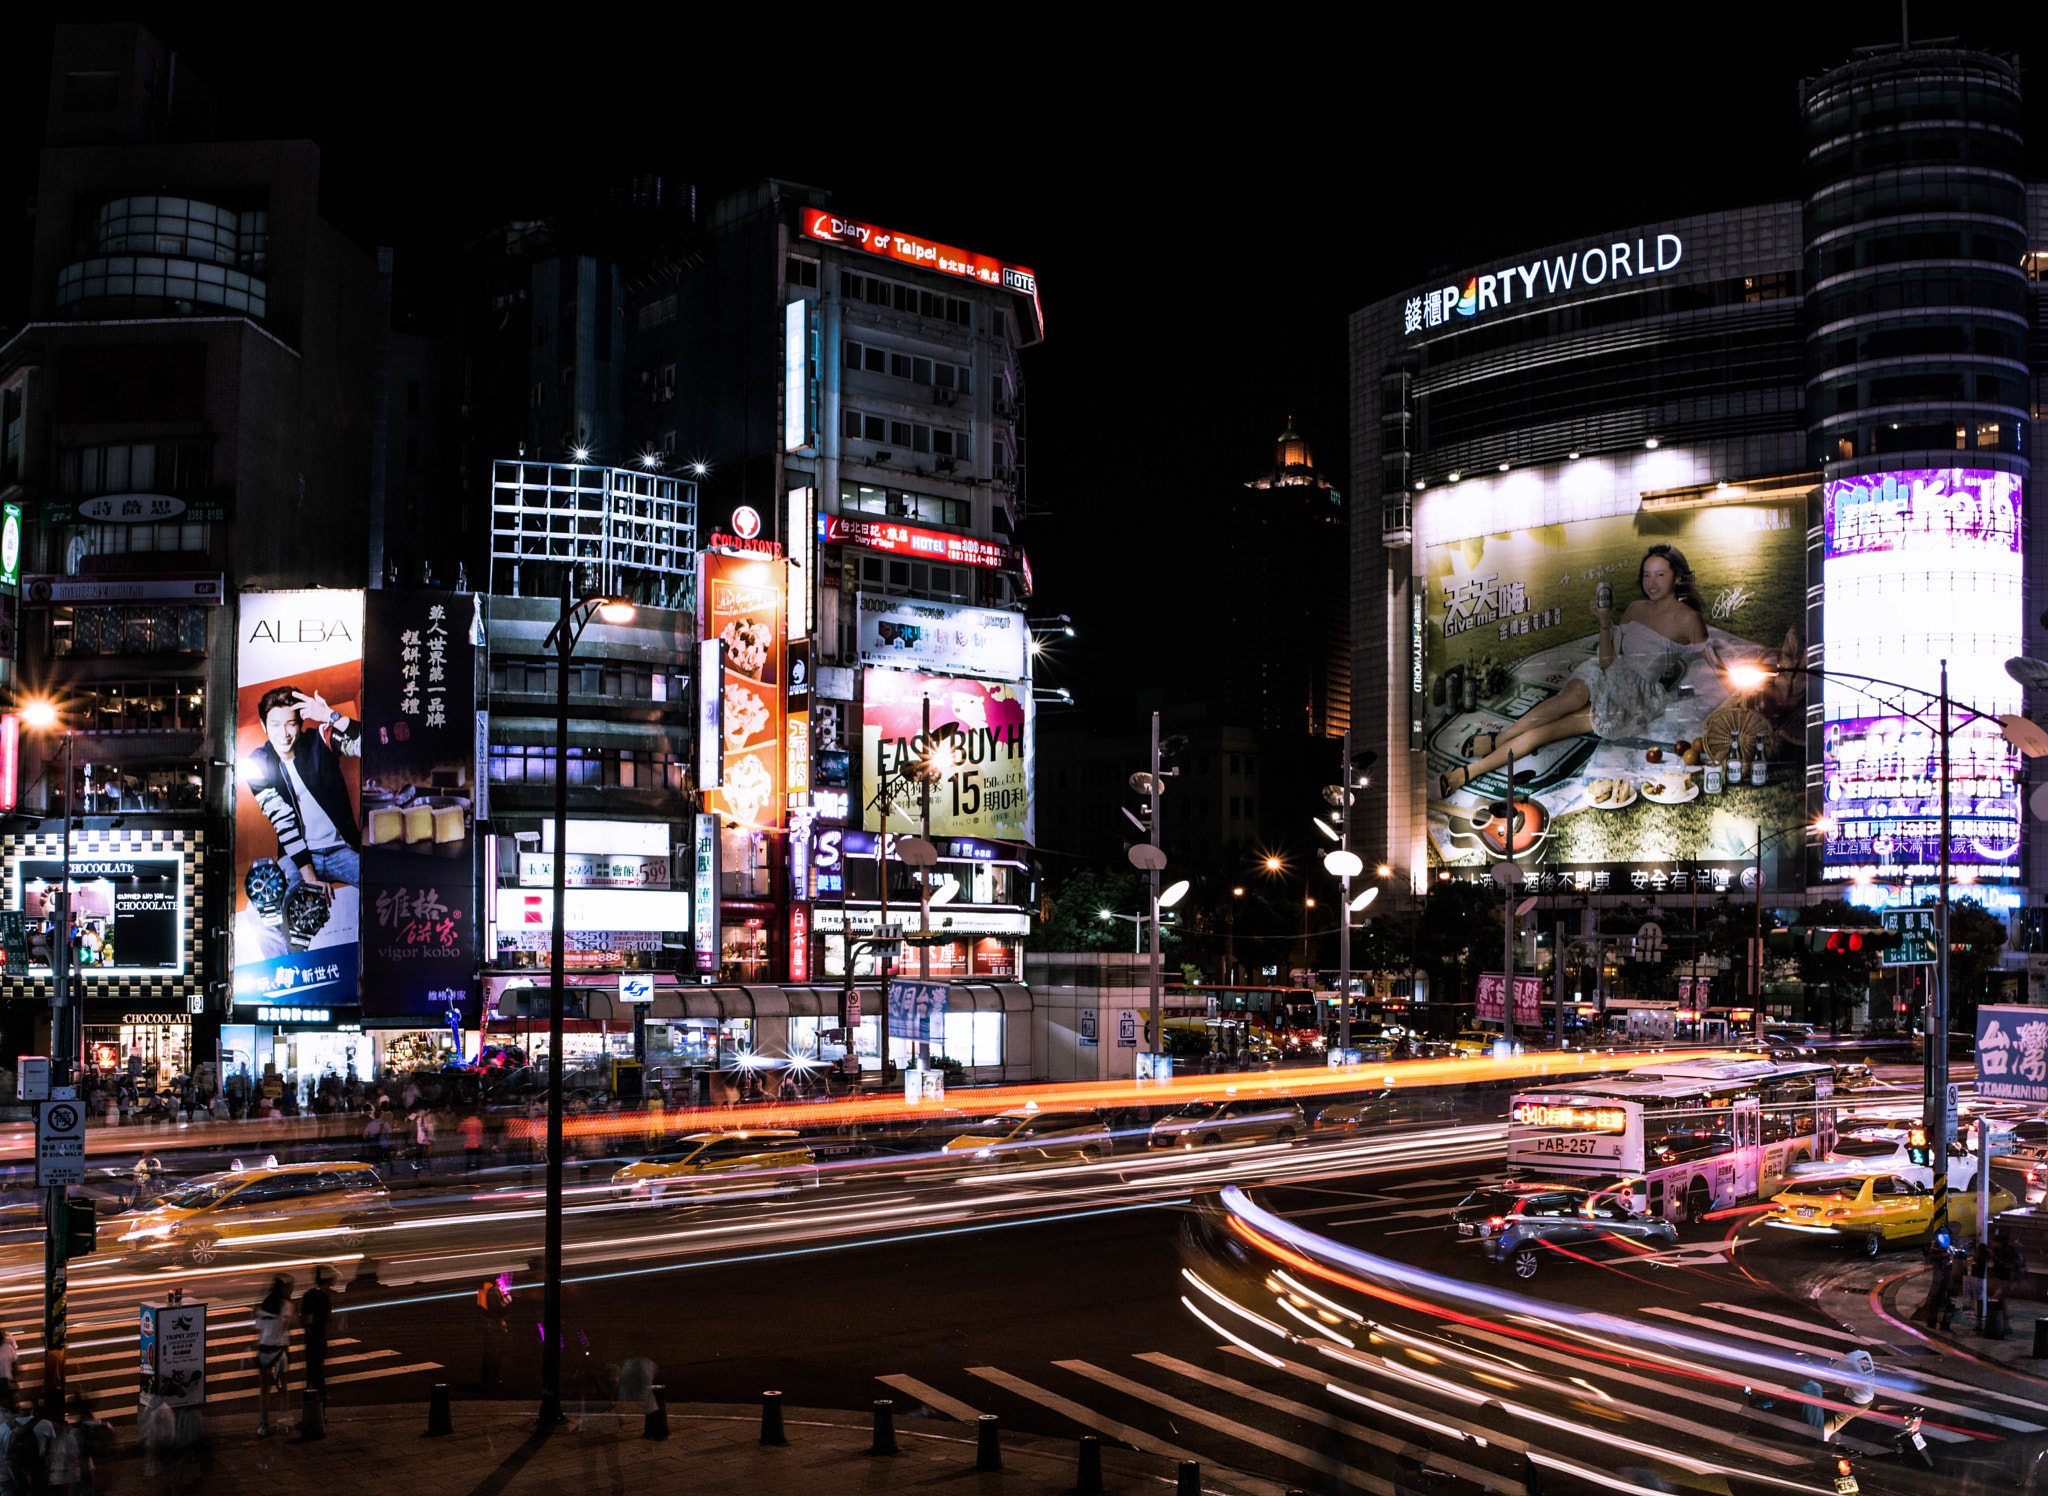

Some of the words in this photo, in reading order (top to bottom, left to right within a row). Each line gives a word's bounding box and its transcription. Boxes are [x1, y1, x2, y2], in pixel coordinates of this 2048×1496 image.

[830, 218, 871, 242] Diary
[874, 234, 890, 249] of
[893, 237, 937, 261] Taipei
[710, 532, 743, 550] COLD
[743, 538, 782, 560] STONE
[911, 536, 945, 553] HOTEL
[1476, 609, 1498, 627] me
[249, 619, 352, 643] ALBA
[949, 725, 1002, 766] BUY
[947, 770, 981, 817] 15
[567, 863, 593, 876] SPA
[1522, 869, 1611, 893] 酒後不開車
[1630, 867, 1731, 891] 安全有保障
[1888, 913, 1930, 930] 成都路
[576, 931, 610, 941] 250
[793, 907, 805, 966] 白木屋
[378, 944, 419, 961] vigor
[423, 944, 461, 959] kobo
[625, 941, 657, 951] 5400
[598, 952, 621, 962] 888
[1978, 1019, 2048, 1082] 台灣
[1537, 1137, 1597, 1154] FAB-257
[165, 1333, 185, 1341] TAIPEI
[185, 1331, 200, 1339] 2017
